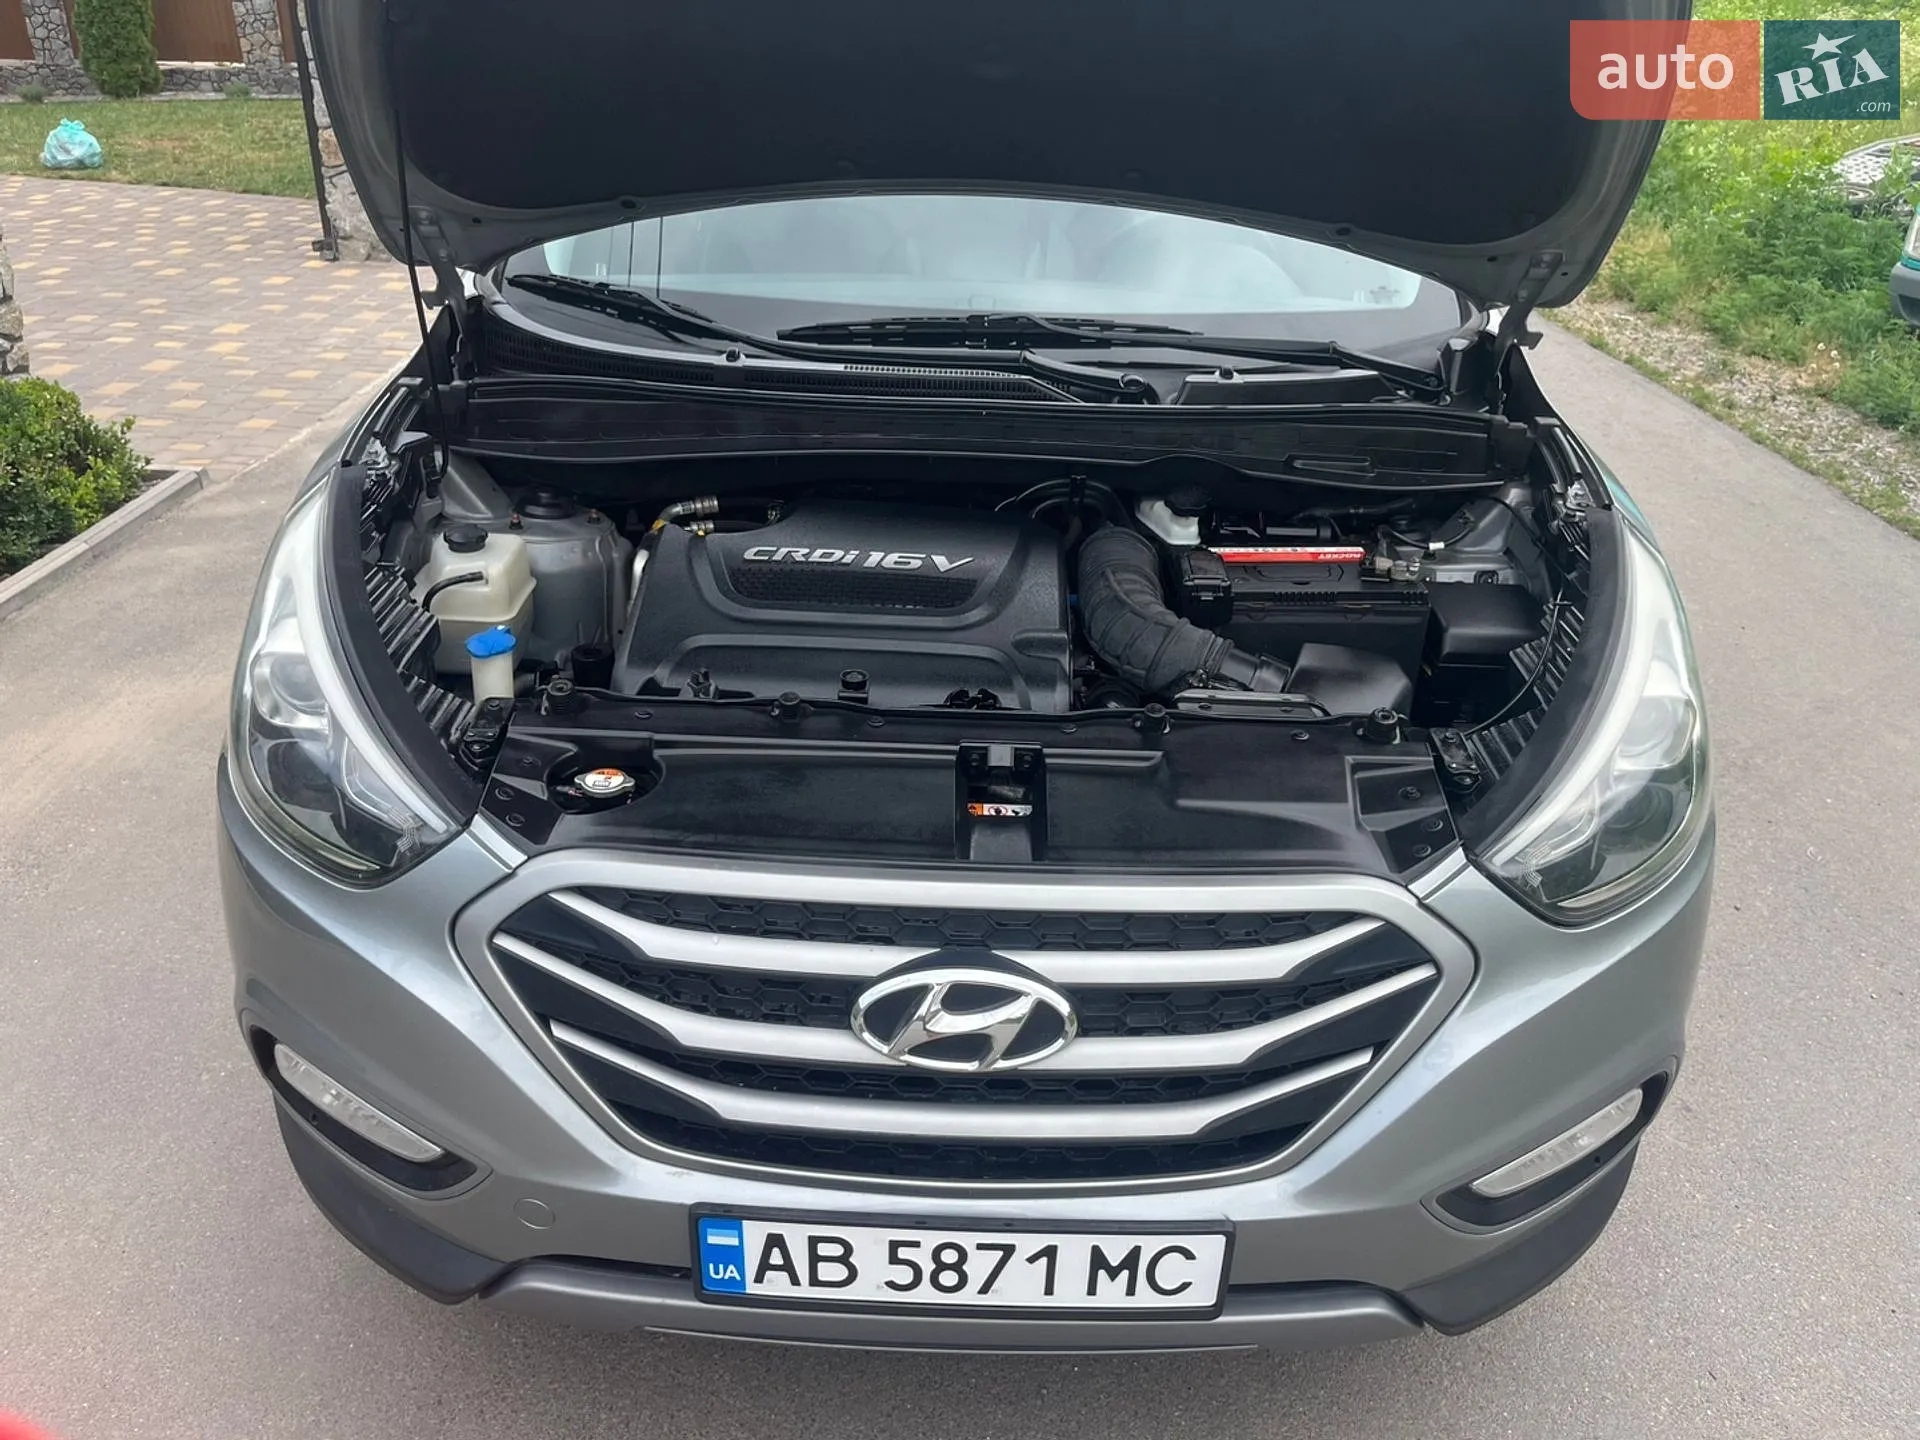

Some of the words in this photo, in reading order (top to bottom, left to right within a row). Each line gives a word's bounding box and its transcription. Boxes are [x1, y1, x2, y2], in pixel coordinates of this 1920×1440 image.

[709, 1263, 742, 1281] UA
[752, 1231, 859, 1288] AB
[884, 1239, 1059, 1296] 5871
[1086, 1244, 1197, 1297] MC
